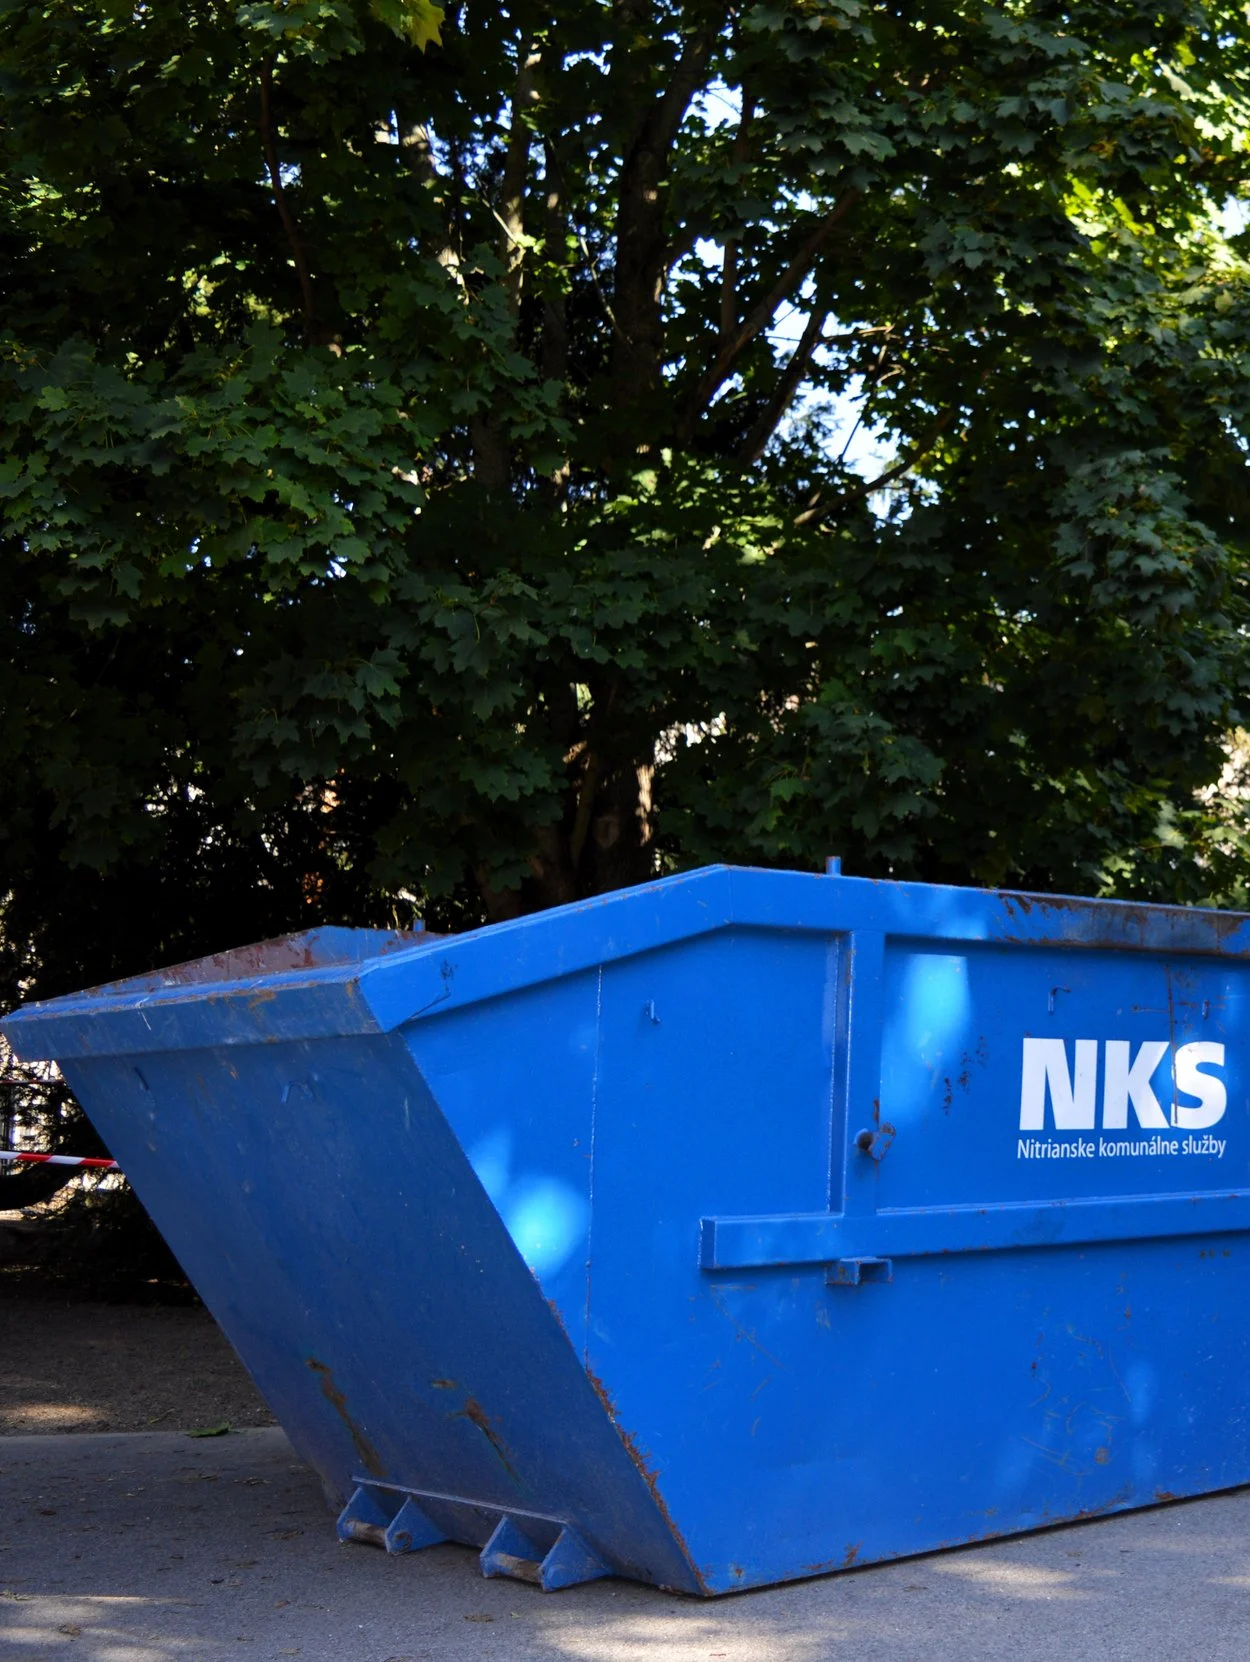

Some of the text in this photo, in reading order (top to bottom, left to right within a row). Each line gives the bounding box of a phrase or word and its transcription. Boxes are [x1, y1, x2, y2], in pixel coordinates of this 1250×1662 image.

[1019, 1038, 1228, 1131] NKS
[1017, 1134, 1226, 1159] Nitrianske komunálne služby
